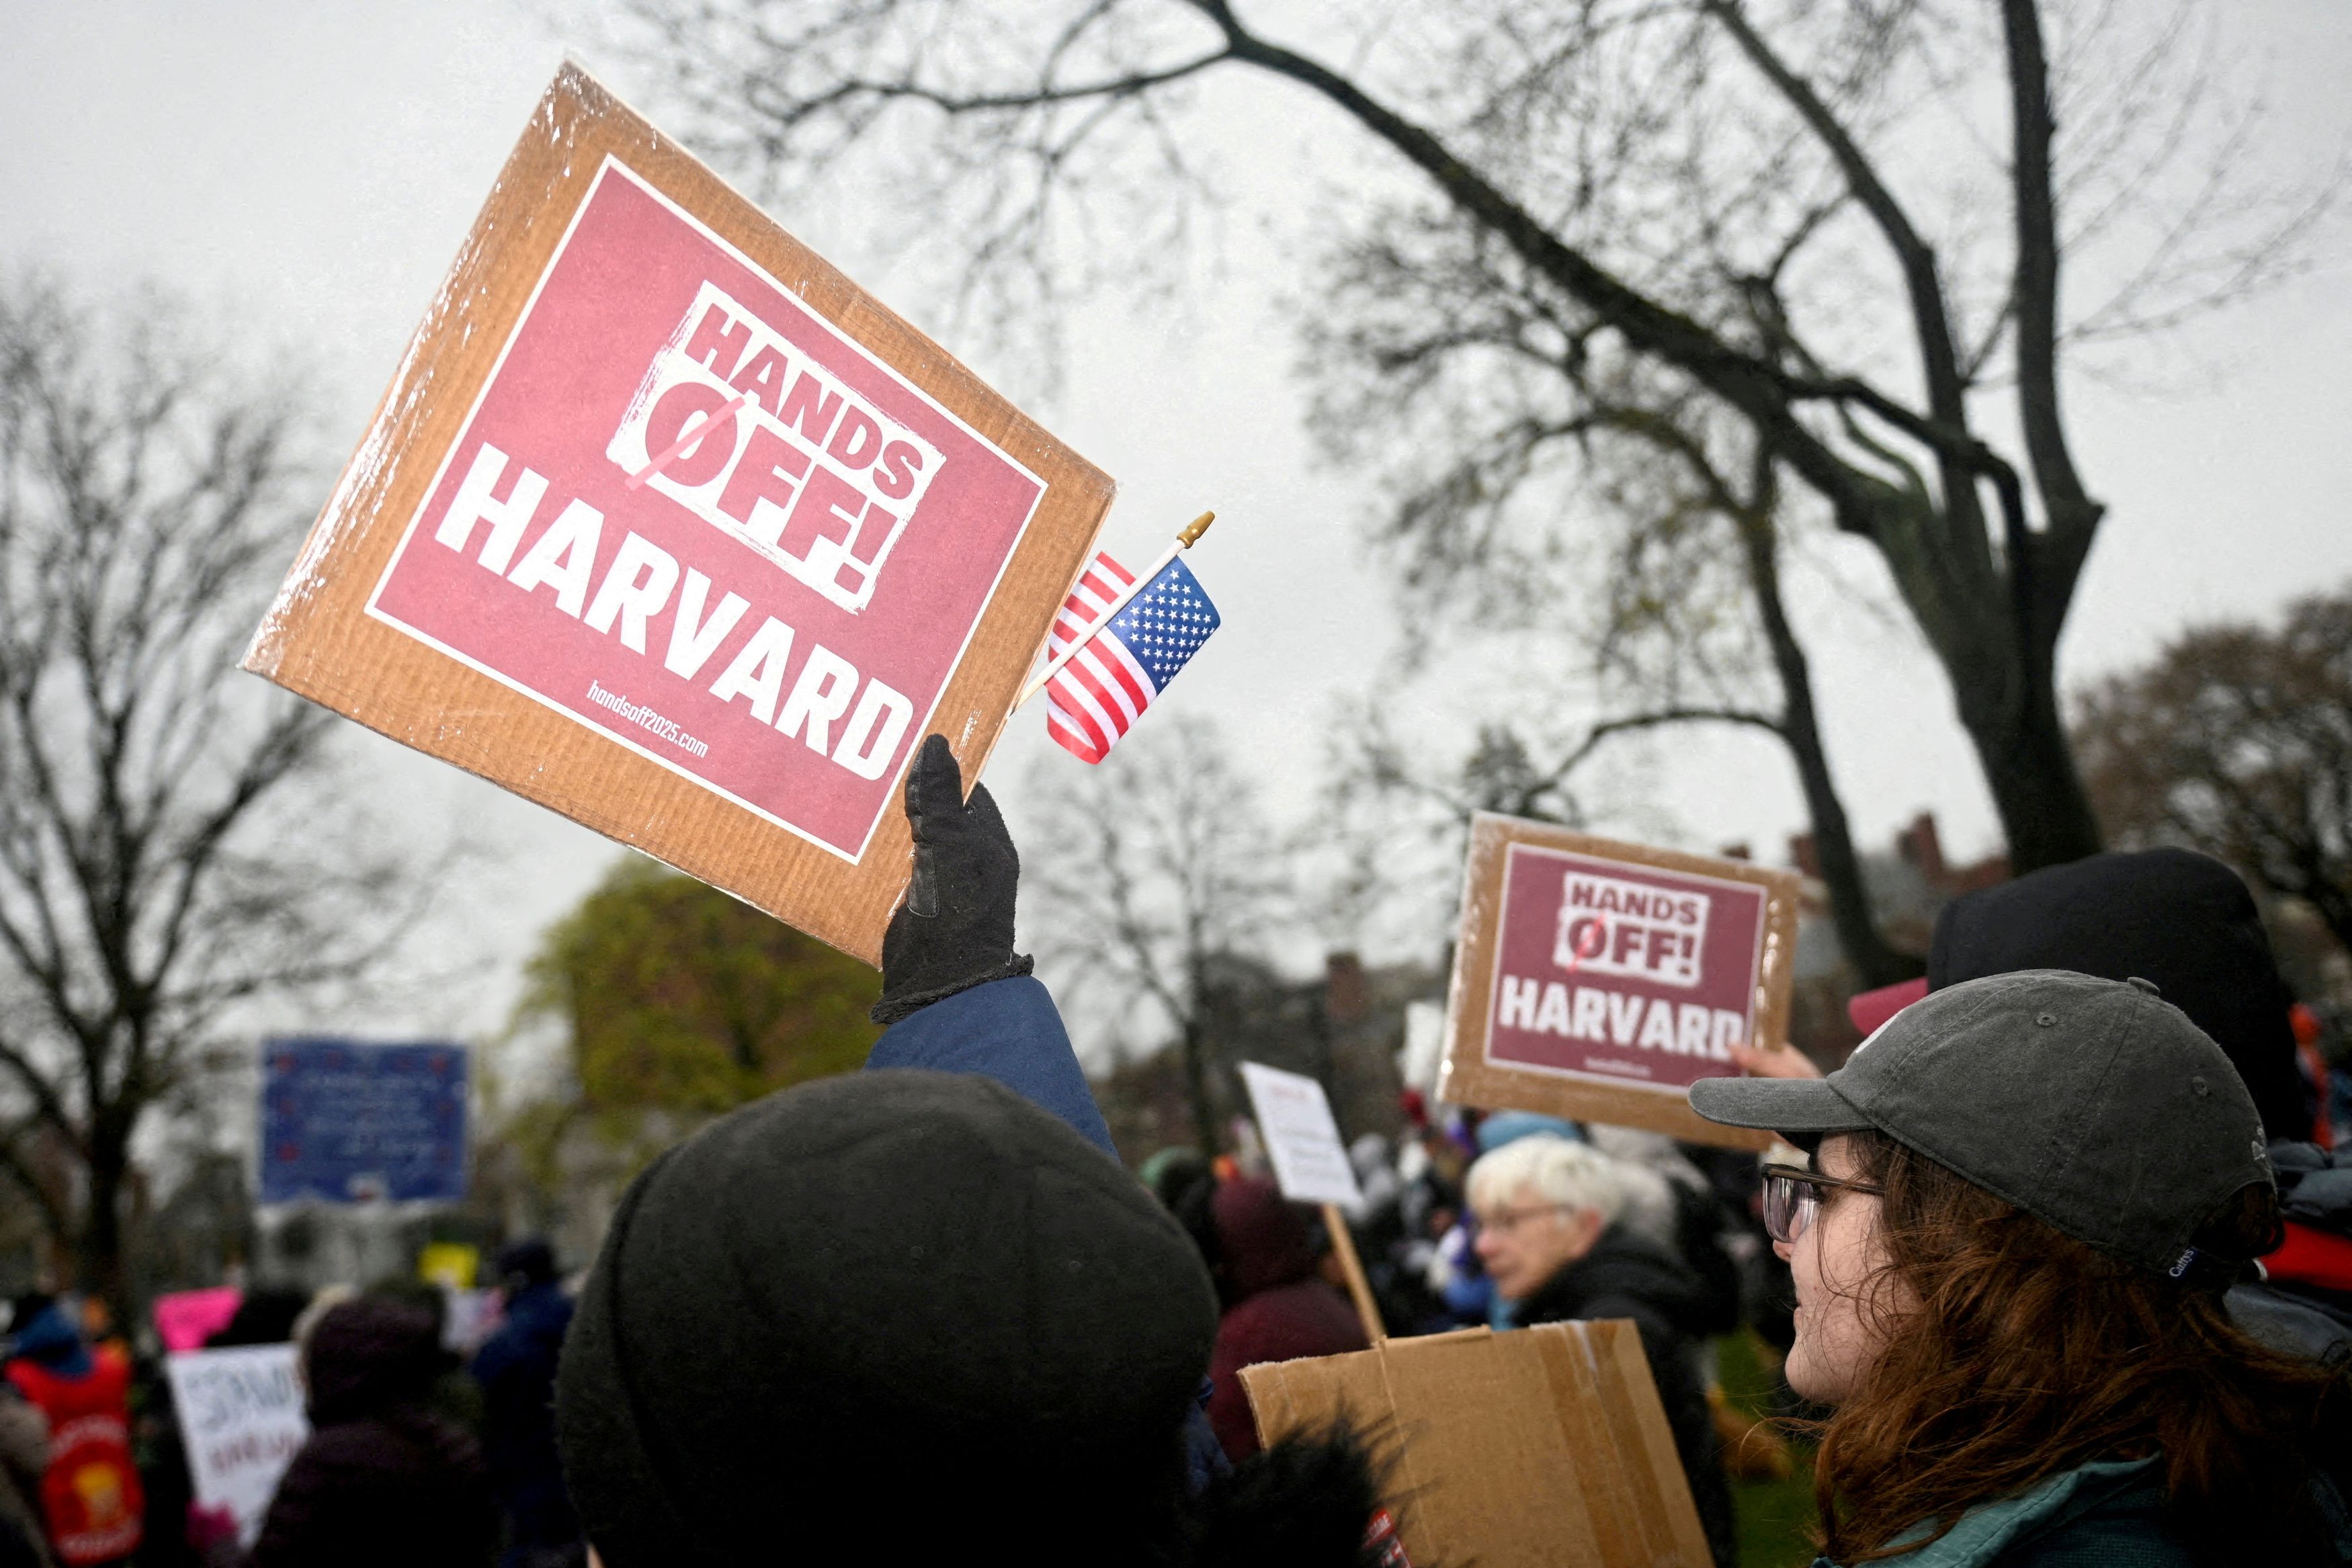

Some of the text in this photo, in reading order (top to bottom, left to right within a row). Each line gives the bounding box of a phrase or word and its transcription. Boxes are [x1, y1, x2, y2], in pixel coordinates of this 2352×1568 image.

[684, 302, 923, 500] HANDS
[644, 382, 898, 595] OFF!
[434, 442, 914, 782] HARVARD
[586, 679, 709, 758] handsoff2025.com
[1571, 881, 1697, 925] HANDS
[1568, 917, 1695, 976] OFF!
[1498, 975, 1745, 1061] HARVARD
